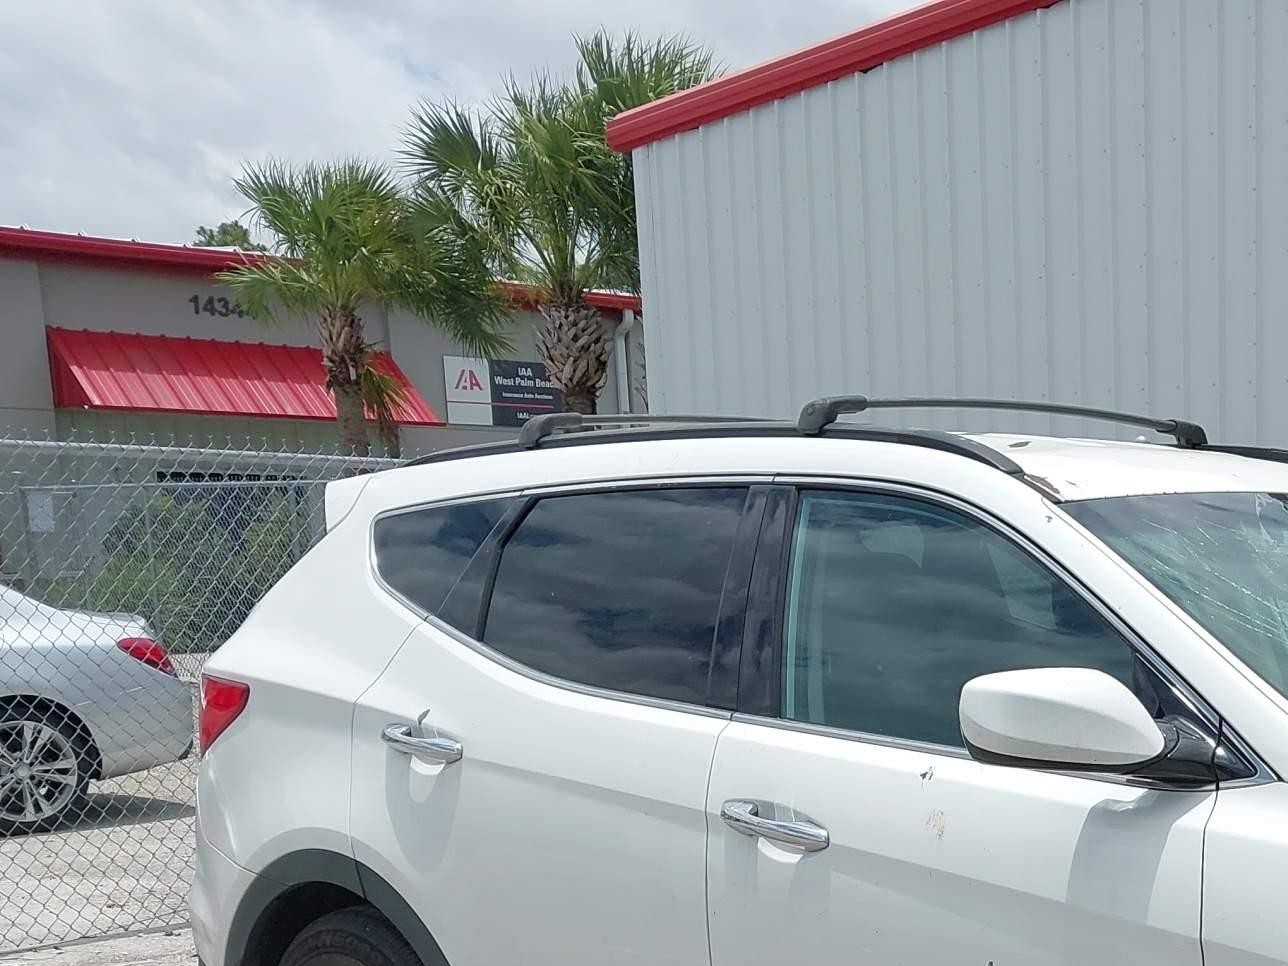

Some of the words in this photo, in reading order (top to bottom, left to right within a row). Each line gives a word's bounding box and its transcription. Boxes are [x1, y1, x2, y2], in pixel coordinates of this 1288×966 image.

[518, 367, 533, 377] IAA
[493, 375, 514, 386] West
[515, 377, 534, 388] Palm
[535, 378, 557, 388] Beac
